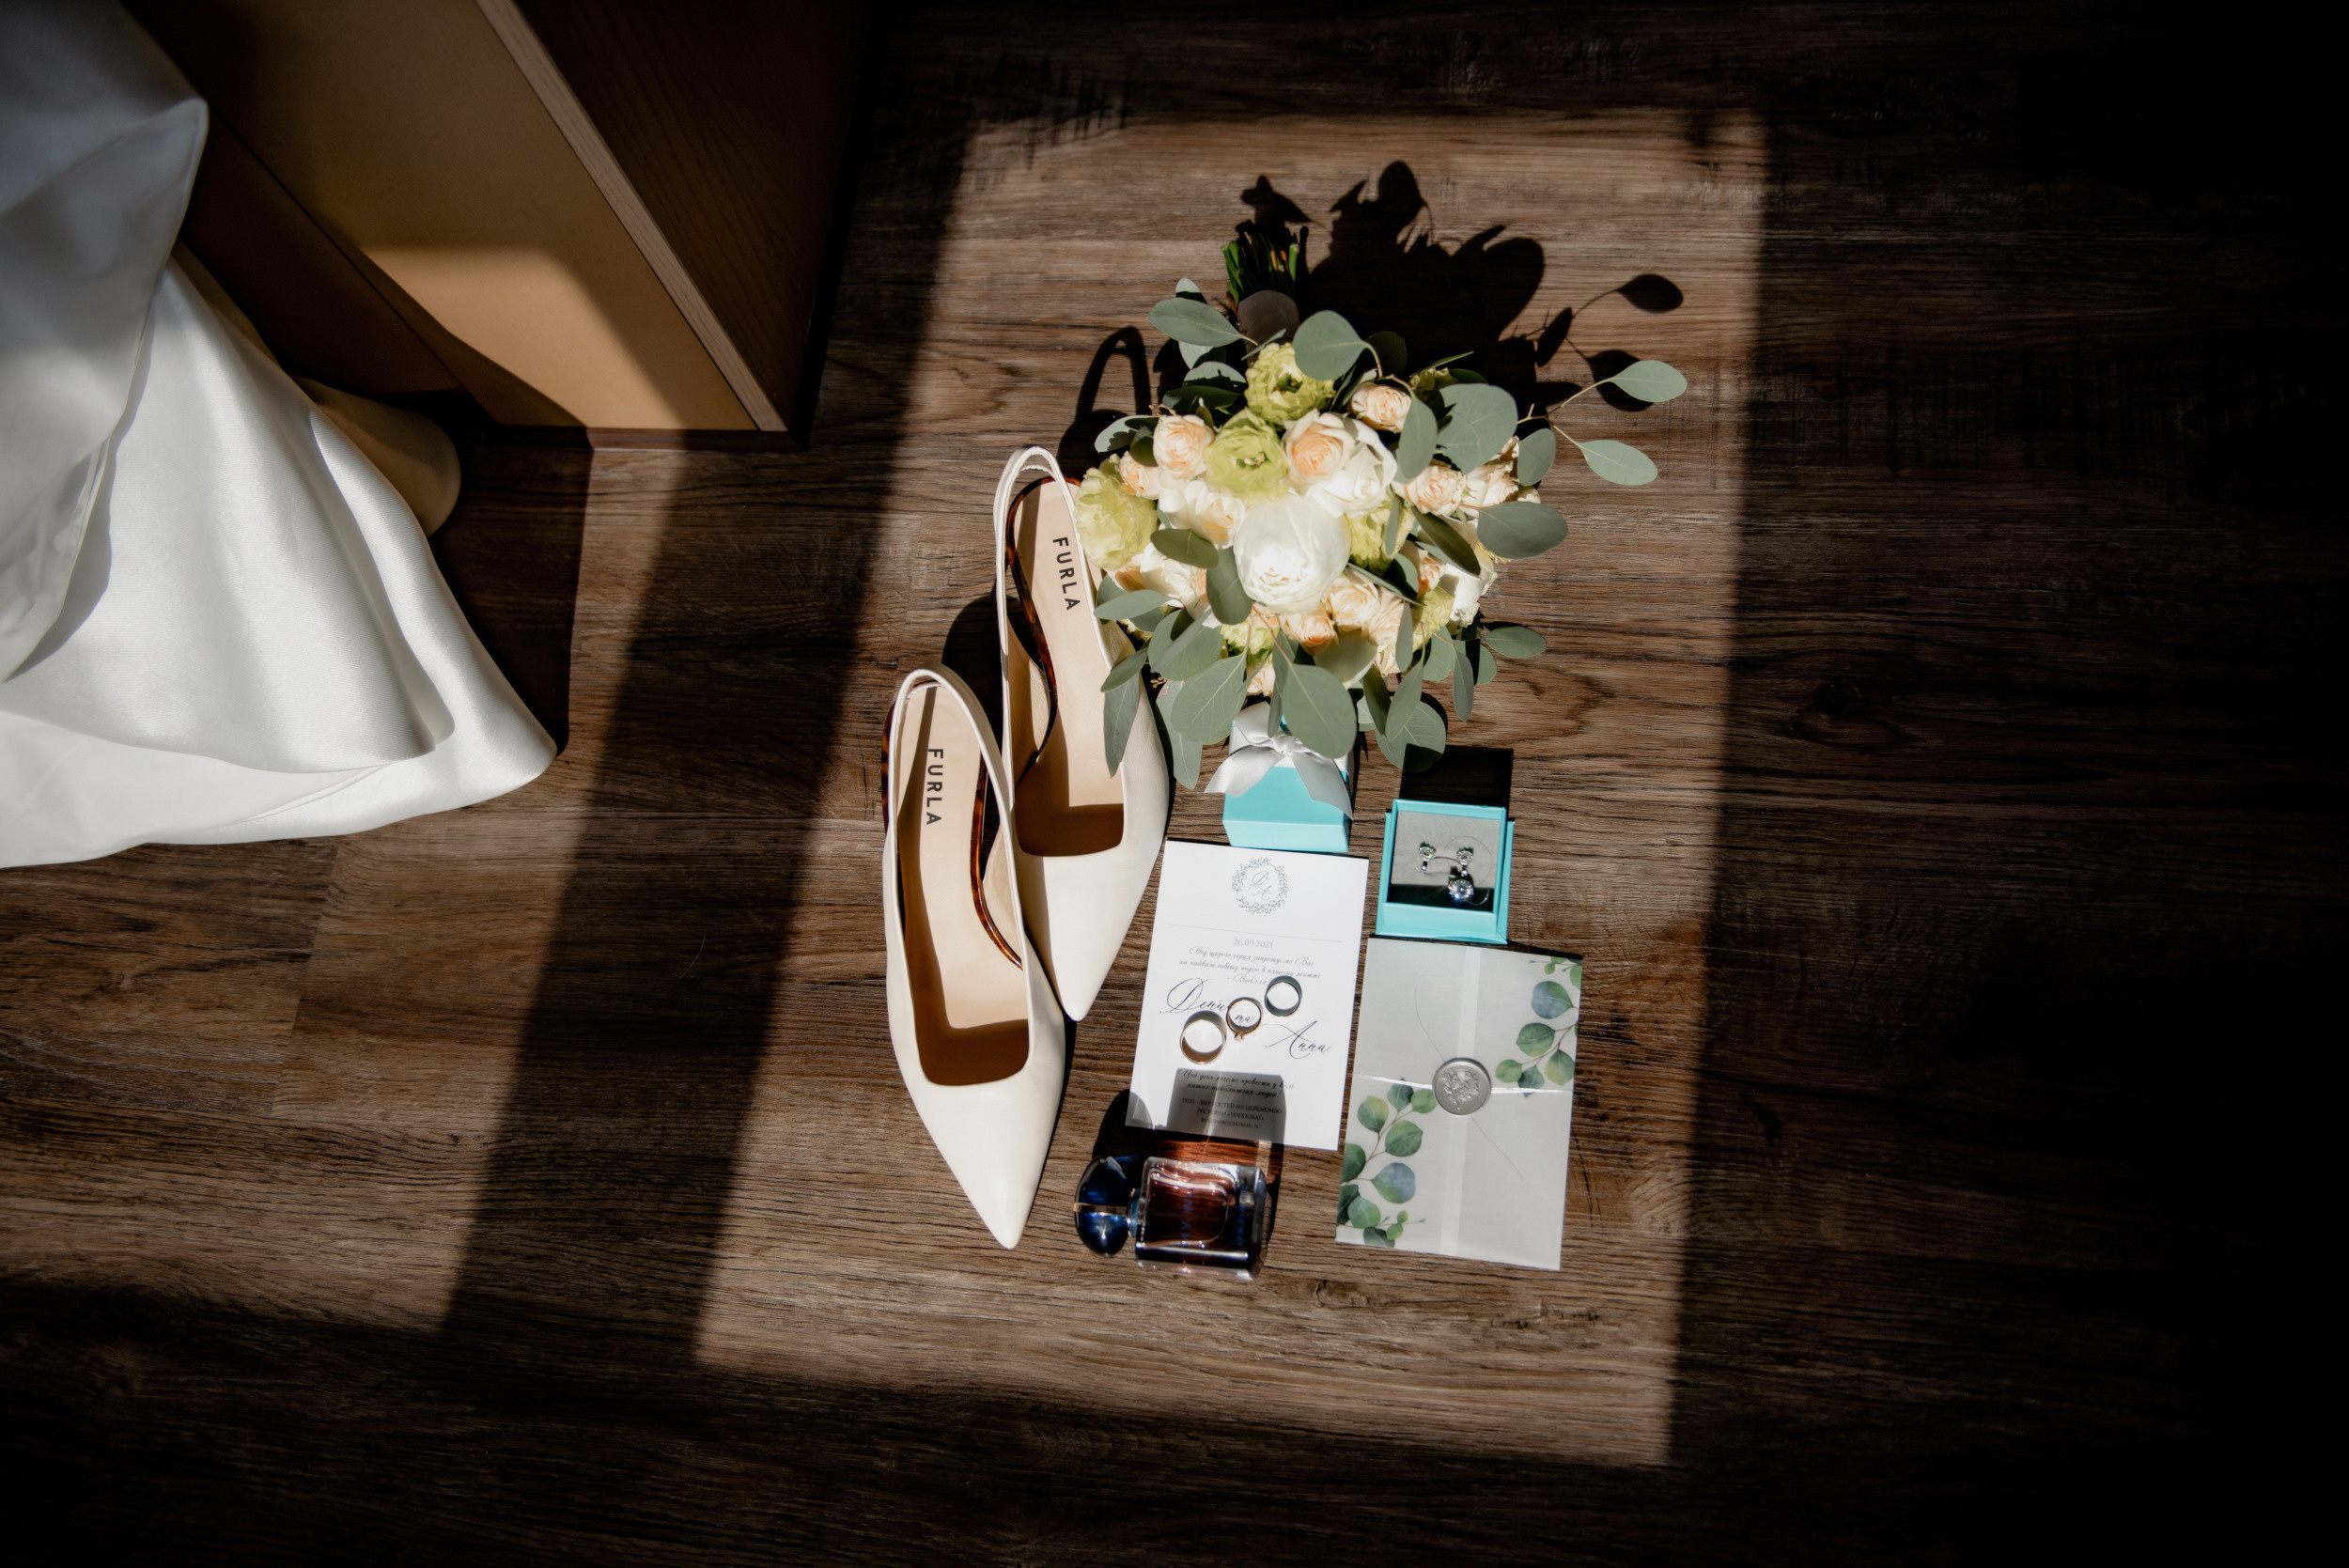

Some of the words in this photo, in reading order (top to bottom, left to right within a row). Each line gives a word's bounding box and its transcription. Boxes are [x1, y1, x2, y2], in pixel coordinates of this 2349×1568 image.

[1052, 536, 1081, 611] FURLA
[926, 749, 943, 825] FURLA
[1189, 945, 1207, 956] Від
[1208, 950, 1232, 959] щирого
[1233, 953, 1252, 961] серця
[1294, 955, 1315, 967] Вас
[1233, 938, 1273, 949] 26.09.2021
[1159, 977, 1230, 1014] Дени
[1235, 1013, 1255, 1023] та
[1260, 1020, 1331, 1059] Анна
